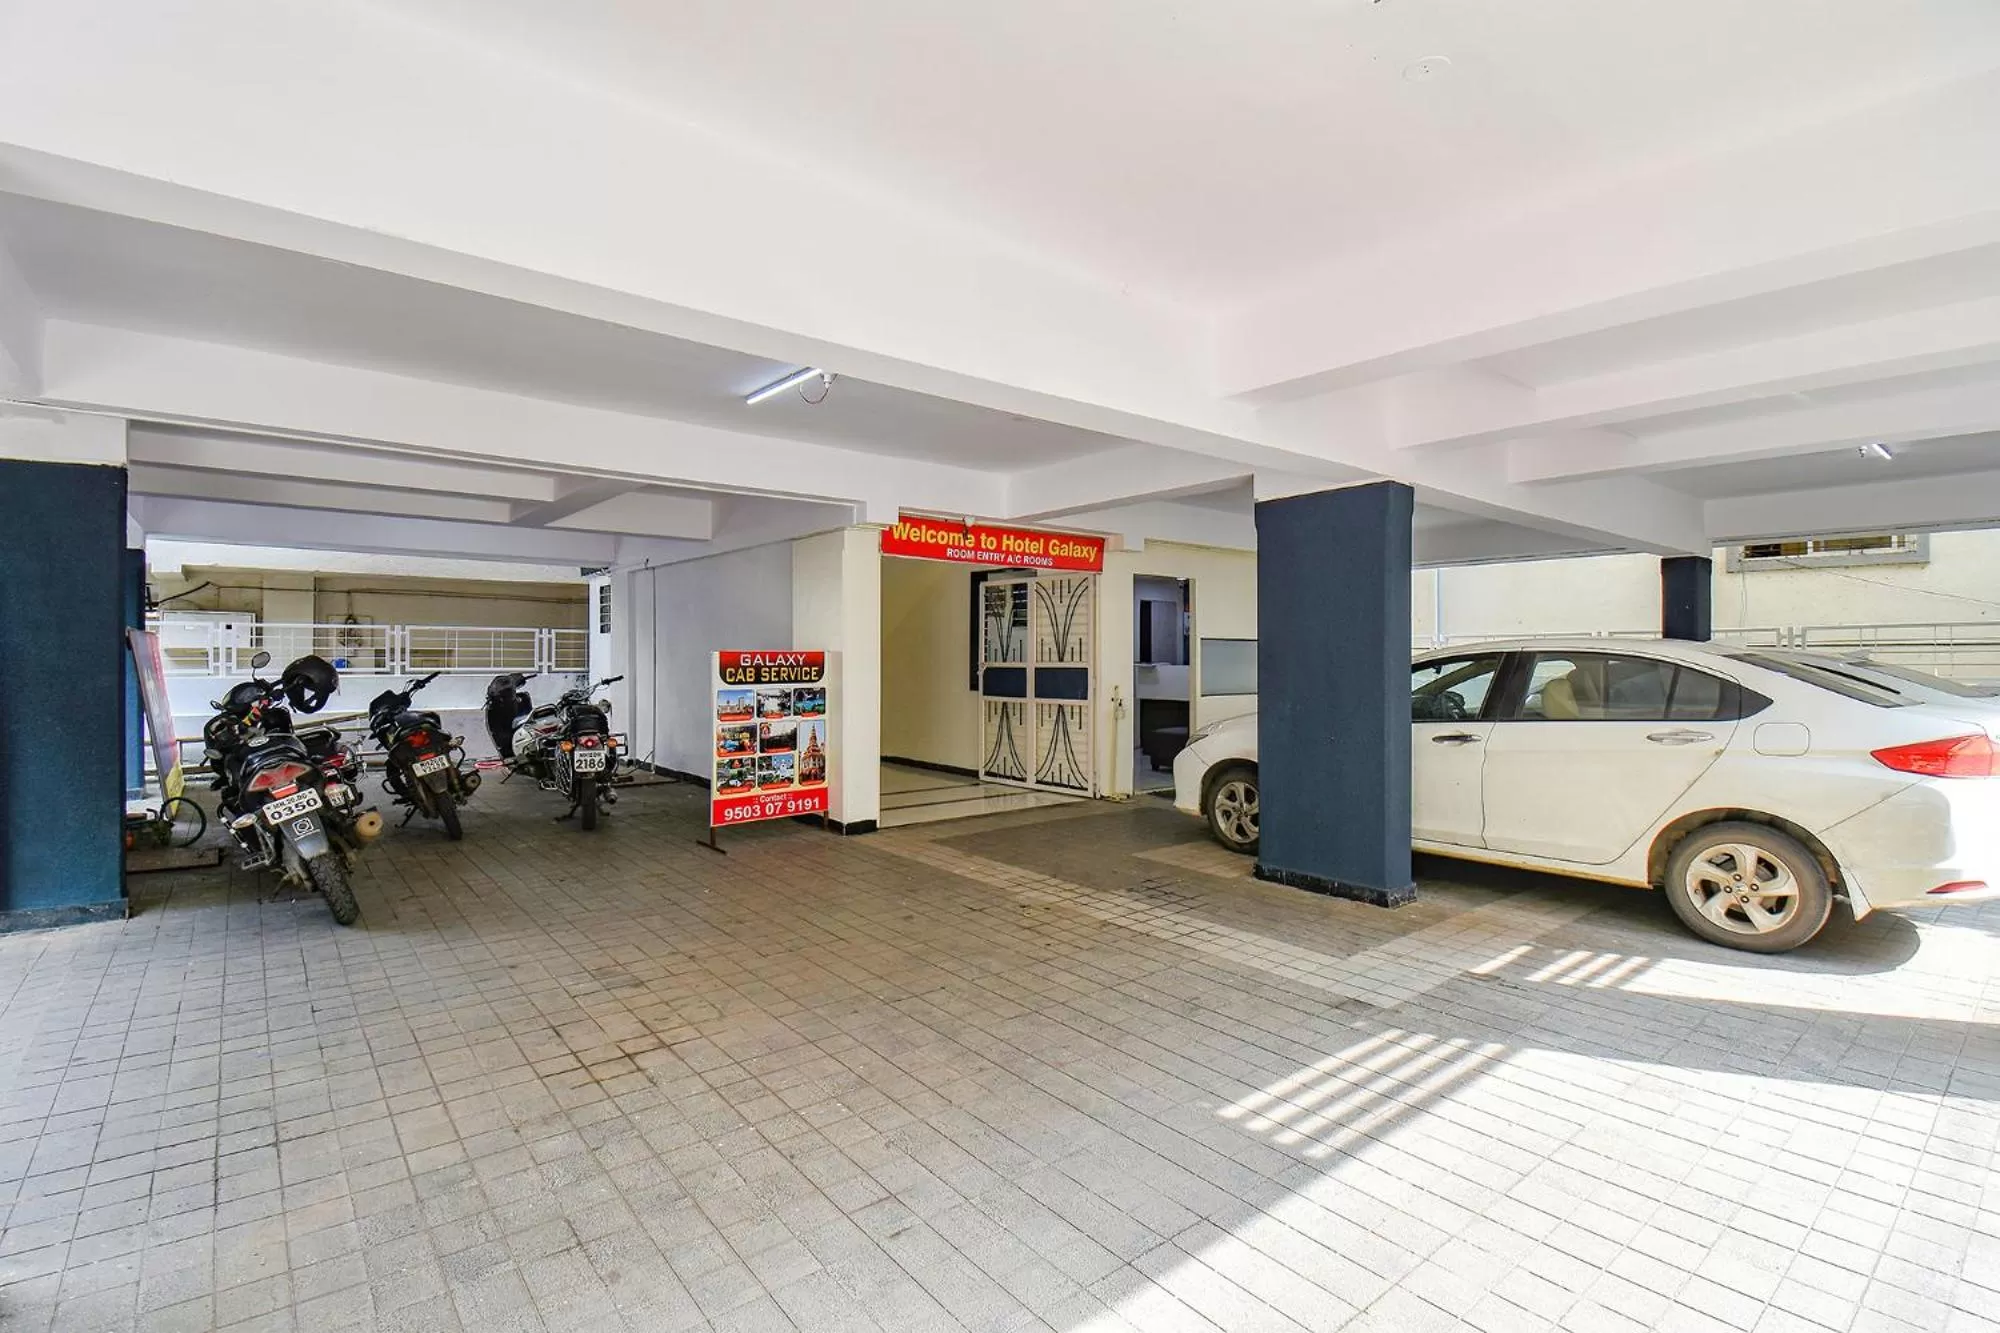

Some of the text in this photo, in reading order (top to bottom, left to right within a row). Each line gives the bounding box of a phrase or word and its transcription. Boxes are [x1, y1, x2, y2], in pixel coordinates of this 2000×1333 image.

[893, 522, 1097, 562] Welcome to Hotel Galaxy
[947, 548, 976, 560] ROOM
[977, 551, 1005, 562] ENTRY
[1023, 555, 1053, 566] ROOMS
[740, 653, 806, 666] GALAXY
[726, 667, 819, 682] CAB SERVICE
[576, 758, 605, 769] 2186
[760, 793, 787, 803] Contact
[271, 798, 318, 820] 0350
[724, 797, 820, 820] 9503 07 9191
